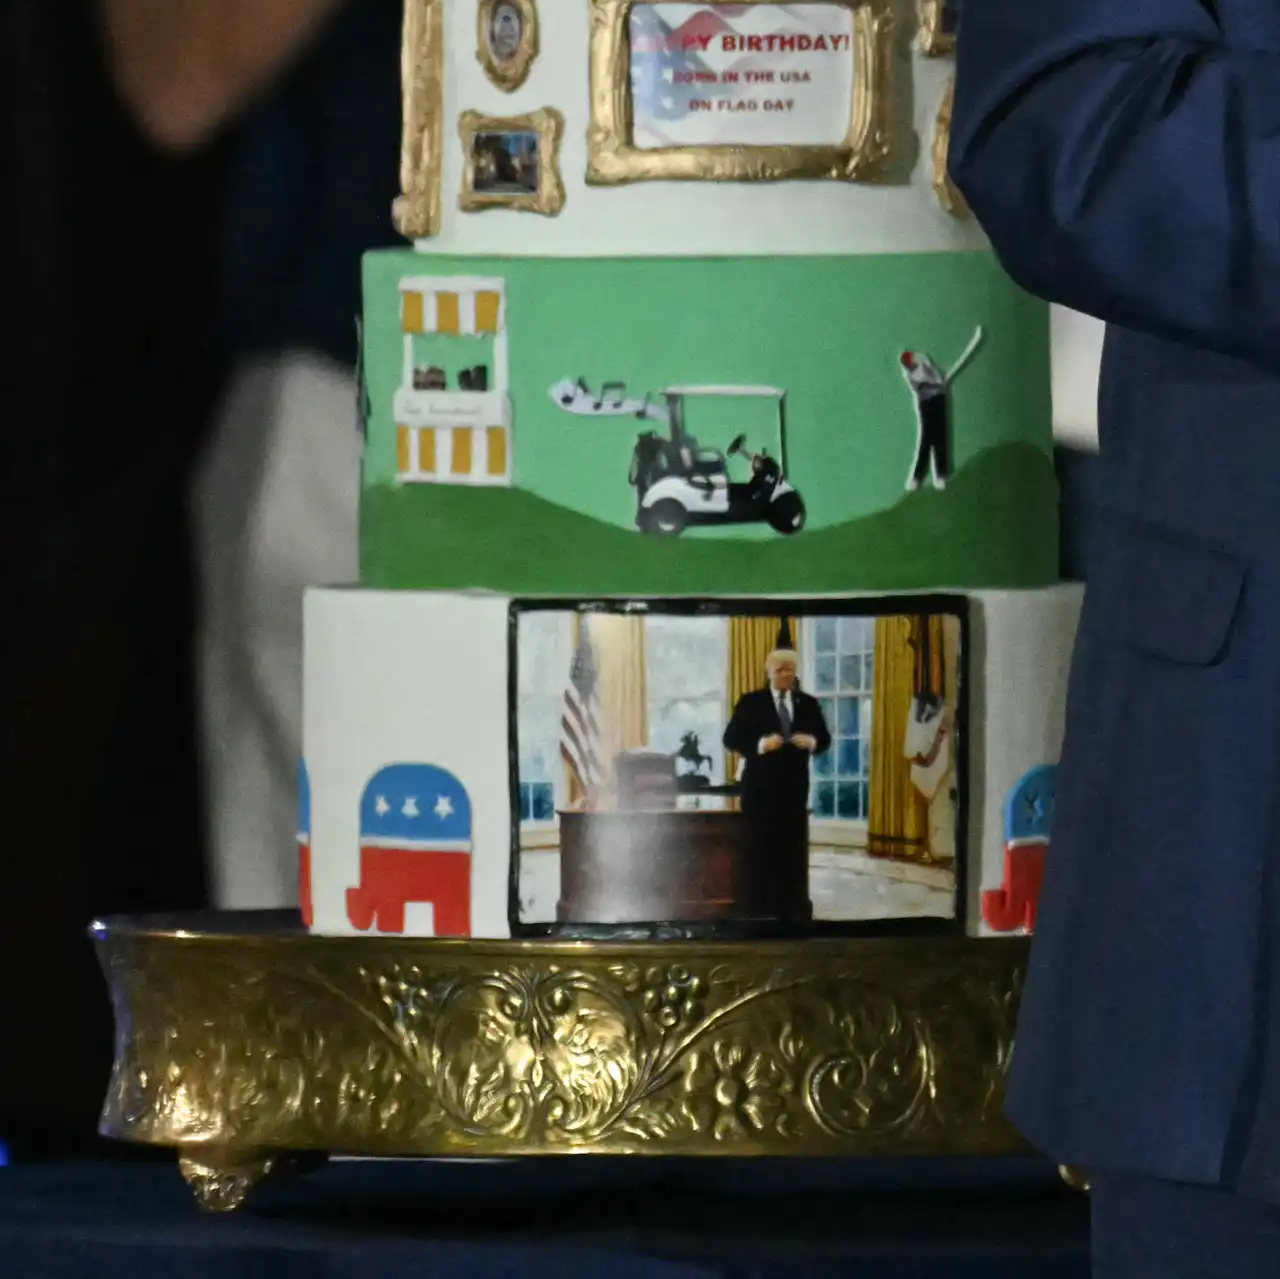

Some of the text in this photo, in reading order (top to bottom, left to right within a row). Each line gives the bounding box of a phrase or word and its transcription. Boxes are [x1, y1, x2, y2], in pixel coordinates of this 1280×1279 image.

[722, 33, 850, 52] BIRTHDAY!
[722, 70, 739, 84] IN
[744, 70, 774, 84] THE
[780, 69, 811, 84] USA
[688, 98, 712, 112] ON
[763, 98, 795, 112] DAY
